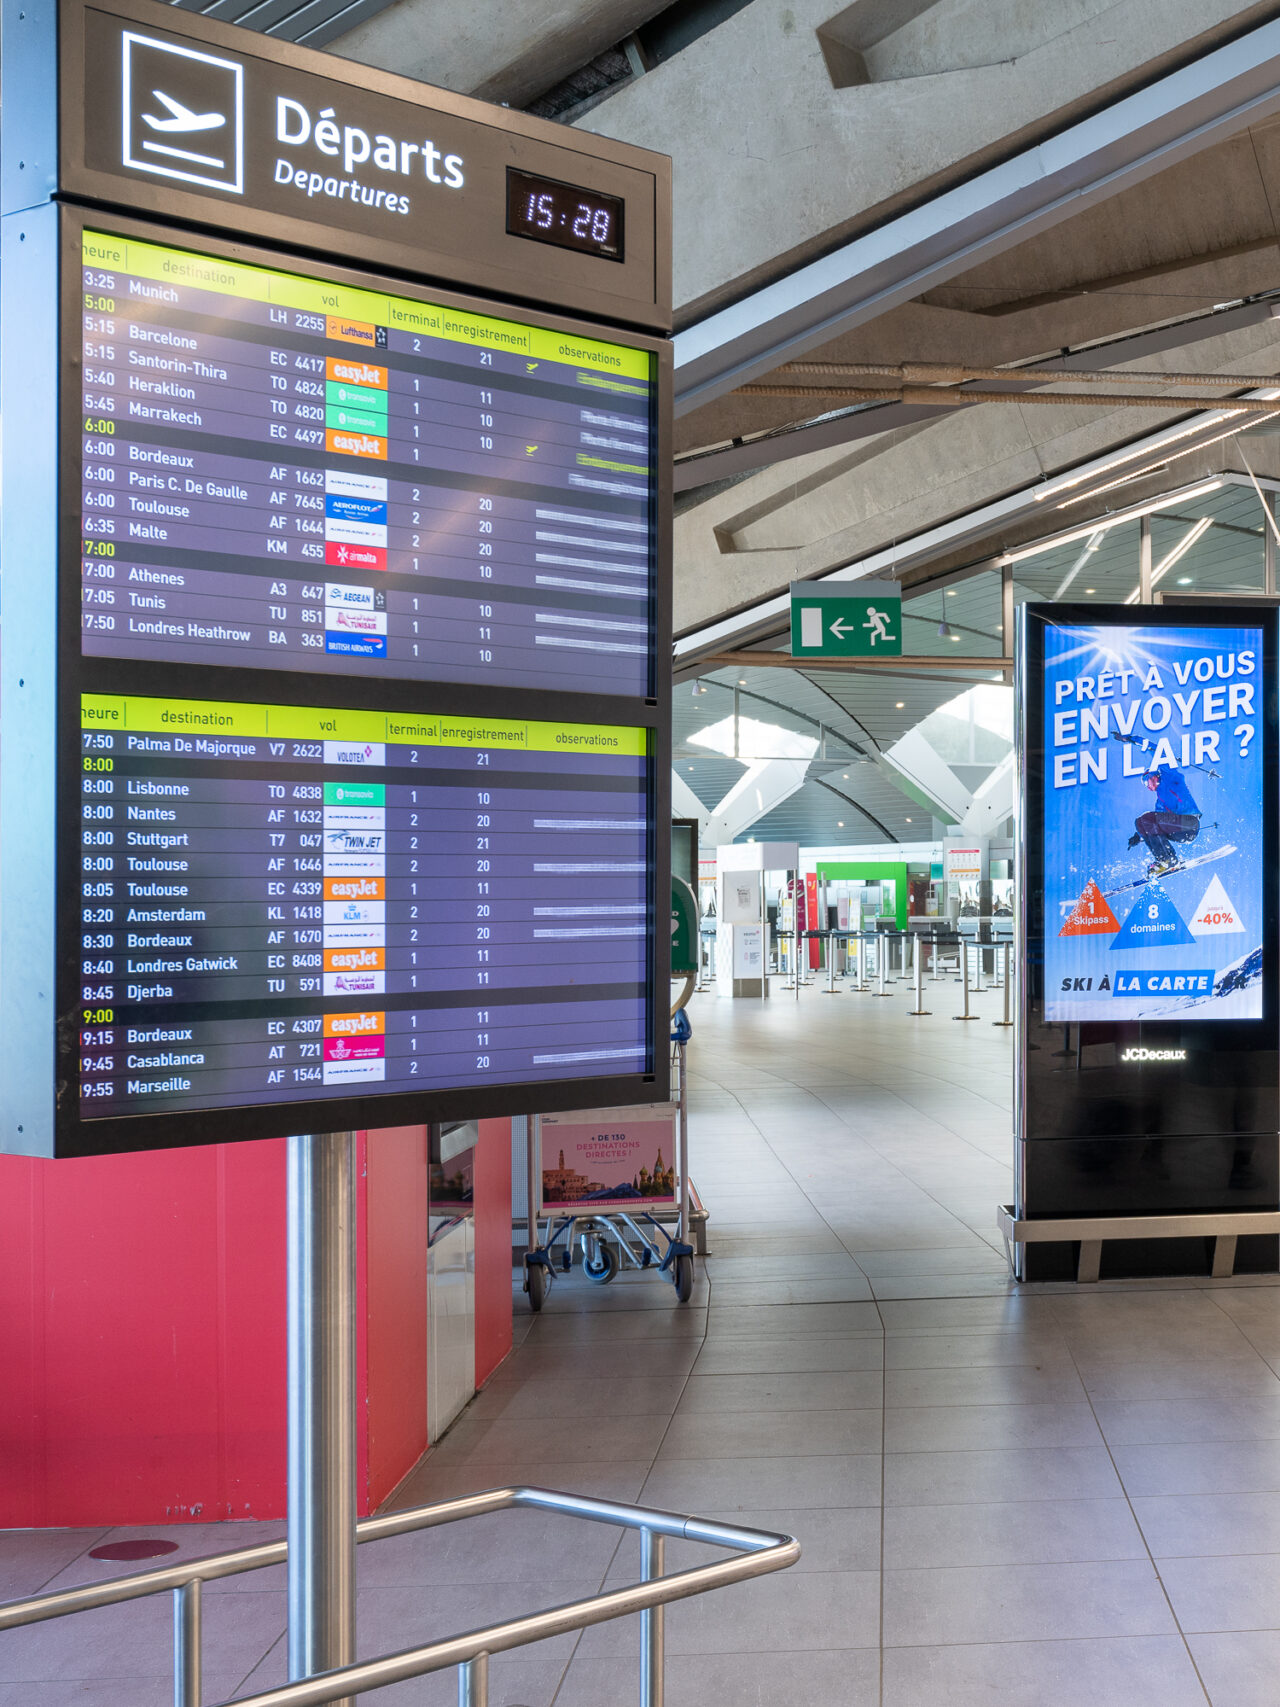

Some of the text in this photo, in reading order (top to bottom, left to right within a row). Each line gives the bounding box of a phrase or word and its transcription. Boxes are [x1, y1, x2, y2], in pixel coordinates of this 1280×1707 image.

[277, 97, 464, 188] Départs
[274, 160, 410, 214] Departures
[525, 193, 611, 243] 15:28
[162, 258, 235, 286] destination
[129, 279, 178, 302] Munich
[269, 308, 287, 324] LH
[295, 313, 324, 331] 2255
[321, 294, 339, 307] vol
[392, 308, 440, 328] terminal
[341, 325, 373, 341] Lufthansa
[444, 321, 526, 346] enregistrement
[128, 323, 197, 350] Barcelone
[270, 350, 287, 366] EC
[294, 355, 324, 372] 4417
[558, 343, 621, 366] observations
[128, 349, 227, 380] Santorin-Thira
[269, 374, 287, 390] TO
[294, 379, 324, 396] 4824
[334, 361, 380, 384] easyJet
[128, 375, 195, 399] Heraklion
[129, 400, 202, 425] Marrakech
[270, 423, 287, 438] EC
[294, 428, 324, 444] 4497
[129, 445, 193, 468] Bordeaux
[269, 466, 287, 480] AF
[295, 470, 323, 486] 1662
[129, 470, 165, 489] Paris
[167, 476, 181, 491] C.
[184, 478, 203, 494] De
[205, 481, 248, 500] Gaulle
[128, 496, 189, 517] Toulouse
[333, 501, 372, 512] AEROFLOT
[128, 521, 323, 558] Malte KM 455
[128, 566, 184, 586] Athenes
[128, 592, 166, 609] Tunis
[344, 592, 370, 604] AEGEAN
[129, 617, 323, 647] Londres Heathrow BA 363
[328, 642, 373, 654] BRITISH AIRWAYS
[1055, 650, 1255, 704] PRÊT À VOUS
[160, 709, 233, 725] destination
[1054, 682, 1255, 747] ENVOYER
[319, 718, 336, 731] vol
[389, 723, 437, 736] terminal
[441, 728, 524, 741] enregistrement
[555, 731, 618, 746] observations
[127, 735, 171, 751] Palma
[174, 737, 192, 752] De
[195, 738, 256, 757] Majorque
[269, 742, 285, 755] V7
[292, 743, 322, 757] 2622
[1054, 724, 1255, 788] EN L'AIR ?
[127, 780, 189, 796] Lisbonne
[267, 784, 285, 798] TO
[292, 785, 322, 799] 4838
[127, 805, 176, 820] Nantes
[127, 831, 188, 848] Stuttgart
[268, 833, 285, 846] T7
[299, 833, 322, 847] 047
[344, 836, 381, 848] TWIN JET
[126, 856, 188, 871] Toulouse
[126, 882, 188, 896] Toulouse
[267, 881, 285, 895] EC
[292, 881, 322, 895] 4339
[126, 907, 205, 921] Amsterdam
[267, 906, 285, 919] KL
[292, 905, 322, 919] 1418
[344, 911, 361, 920] KLM
[1087, 902, 1095, 914] 1
[1148, 904, 1159, 920] 8
[1074, 914, 1109, 926] Skipass
[1198, 912, 1233, 925] -40%
[1130, 922, 1176, 934] domaines
[127, 932, 192, 947] Bordeaux
[127, 958, 183, 972] Londres
[185, 956, 238, 971] Gatwick
[267, 954, 285, 968] EC
[292, 953, 322, 967] 8408
[1061, 974, 1208, 992] SKI À LA CARTE
[127, 983, 172, 1002] Djerba
[127, 1027, 192, 1043] Bordeaux
[127, 1052, 204, 1068] Casablanca
[1122, 1048, 1186, 1061] JCDecaux
[127, 1076, 191, 1094] Marseille
[576, 1141, 640, 1150] DESTINATIONS
[586, 1150, 627, 1158] DIRECTES
